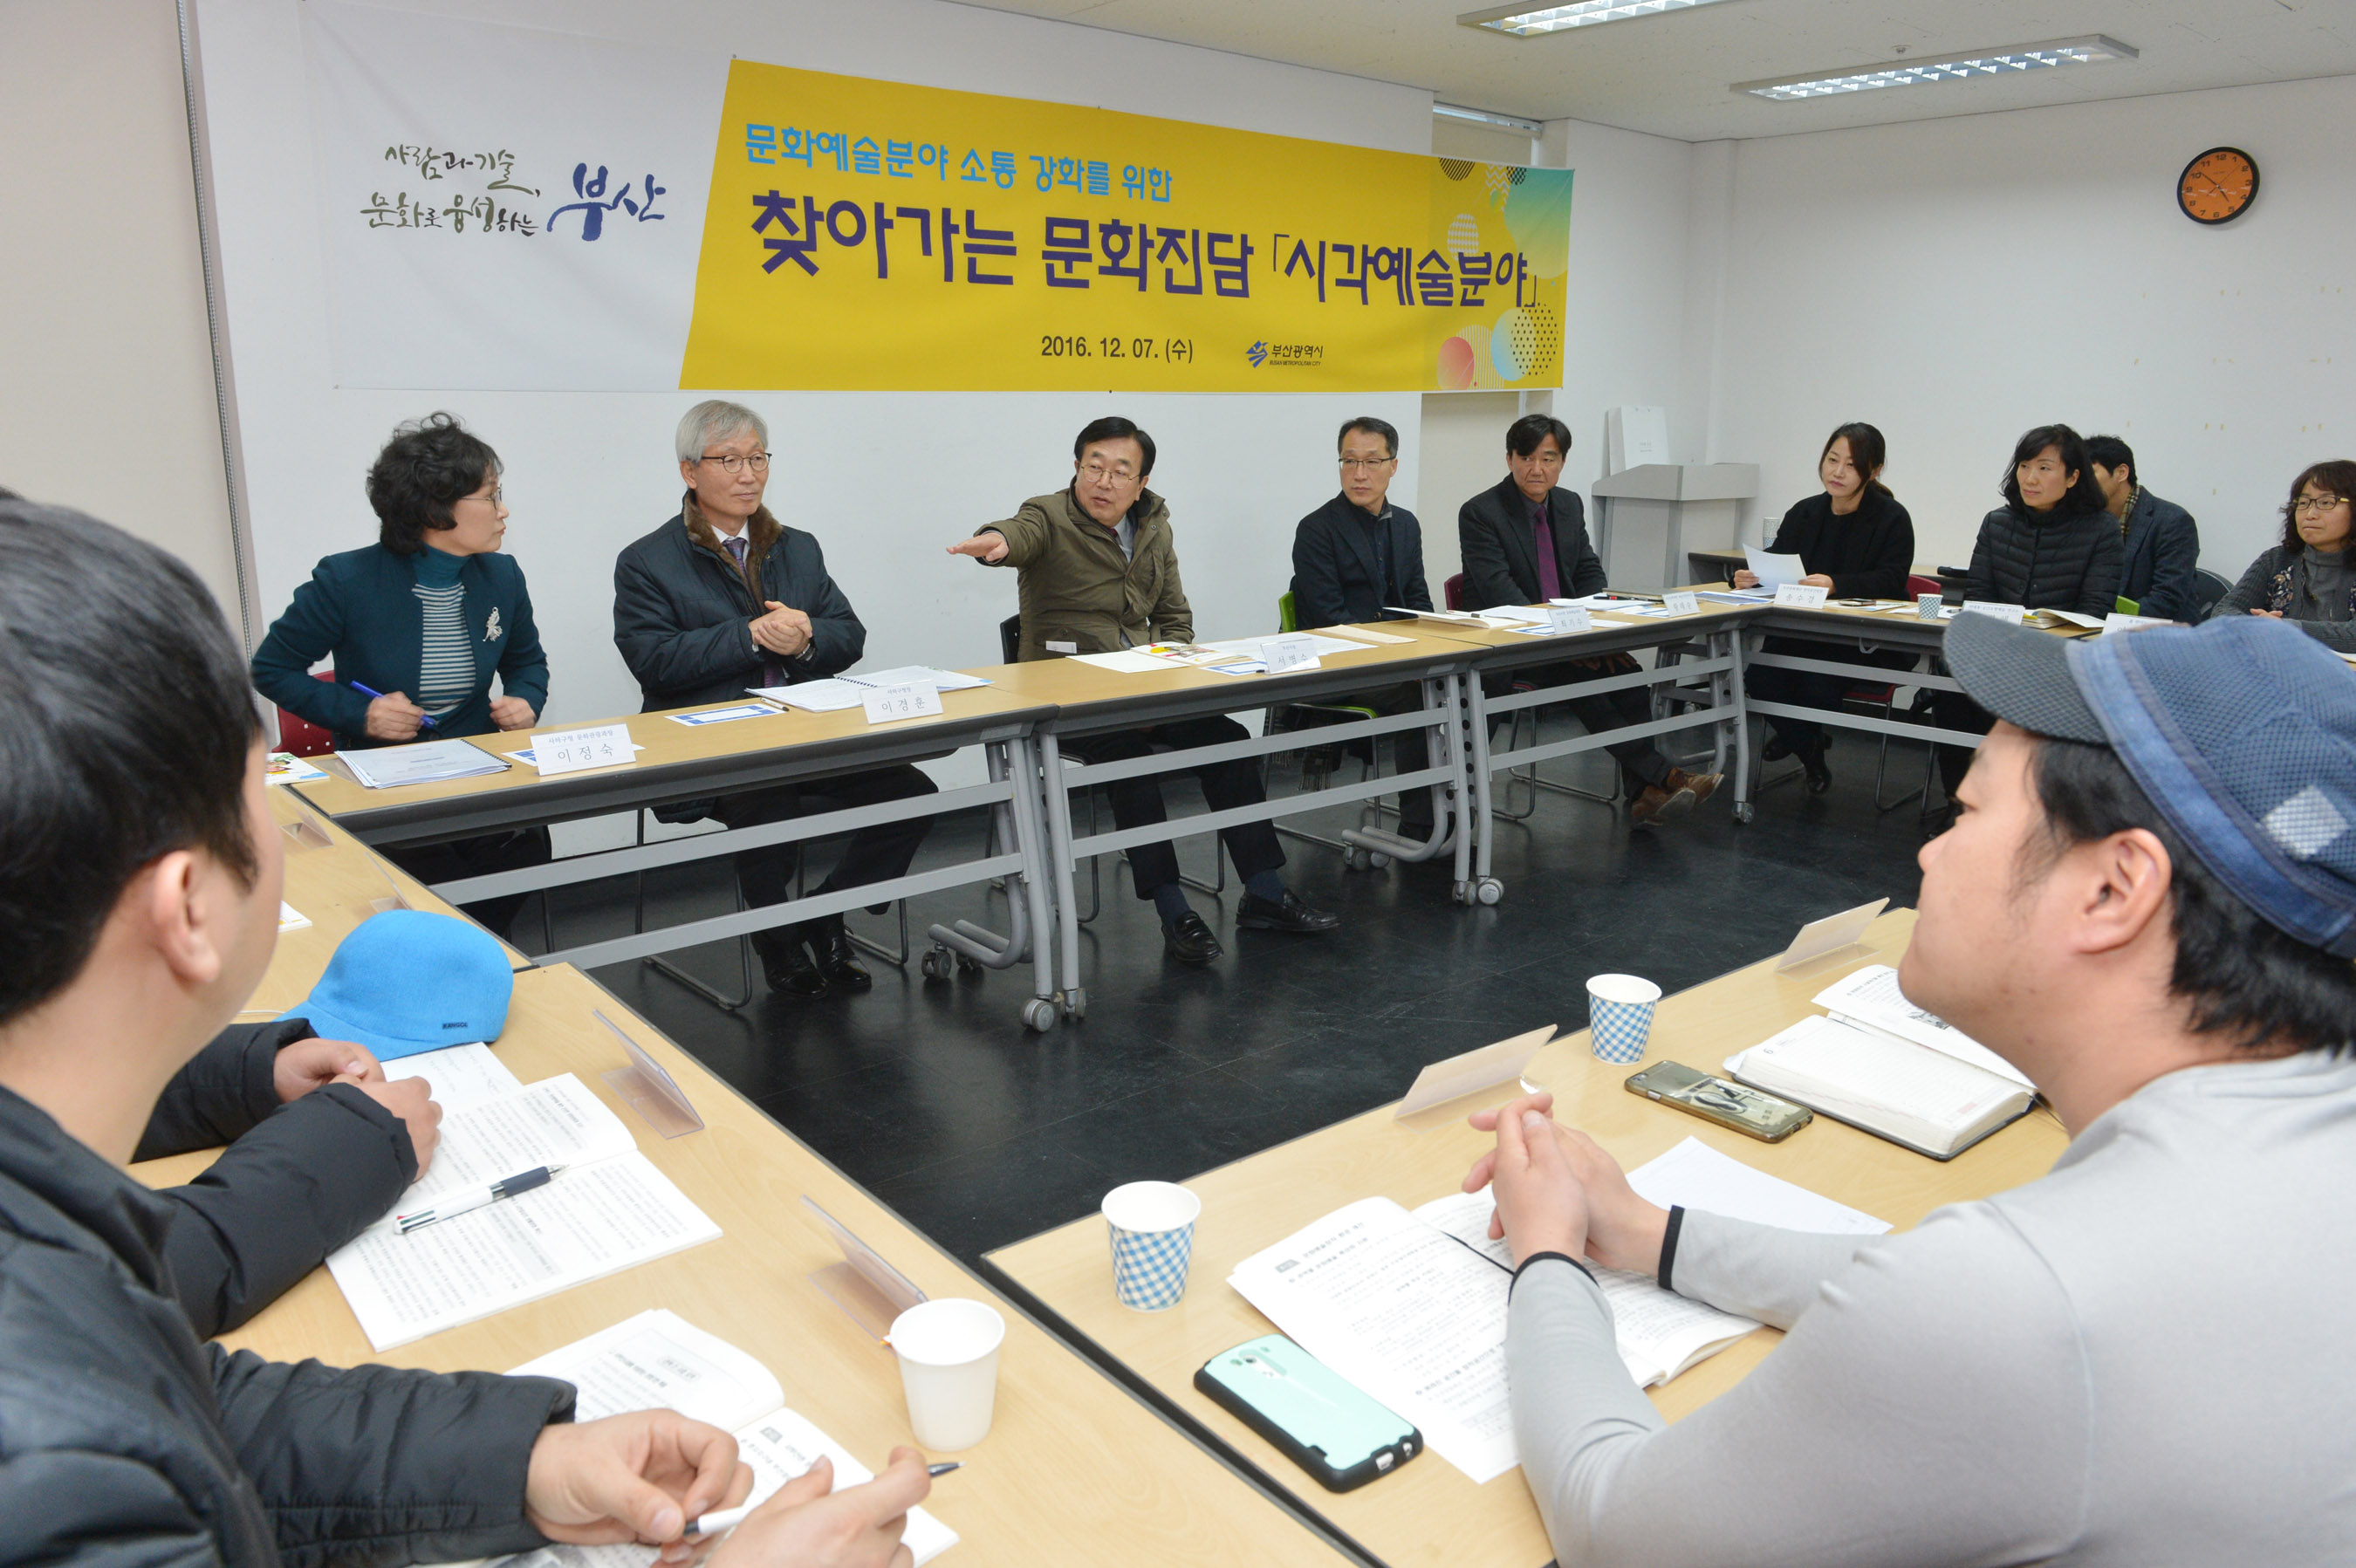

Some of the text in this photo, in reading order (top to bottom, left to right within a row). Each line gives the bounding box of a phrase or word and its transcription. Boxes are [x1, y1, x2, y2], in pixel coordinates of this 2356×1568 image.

[385, 144, 474, 180] 사람과
[745, 123, 1173, 202] 문화예술분야 소통 강화를 위한
[360, 162, 666, 242] 문화로 융성하는 부산
[750, 189, 1017, 285] 찾아가는
[1041, 216, 1254, 298] 문화진담
[1041, 335, 1194, 364] 2016. 12. 07. (수)
[1271, 344, 1324, 359] 부산광역시
